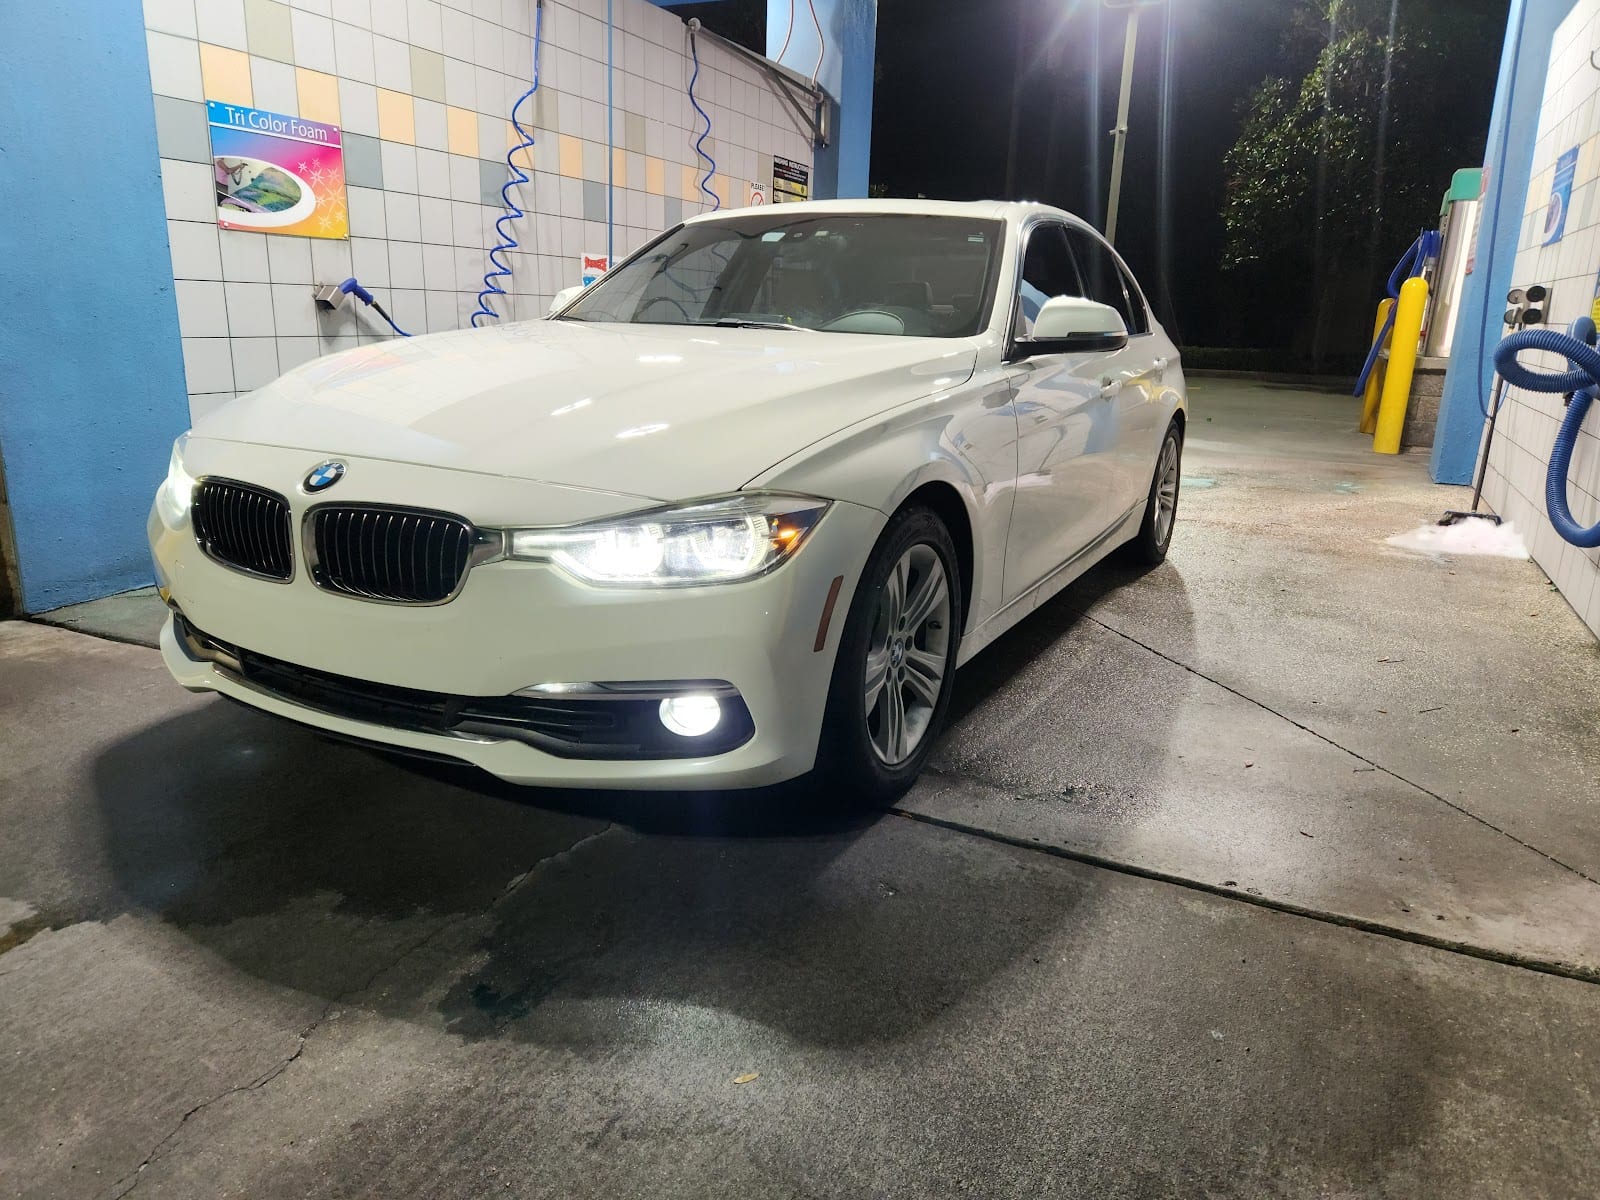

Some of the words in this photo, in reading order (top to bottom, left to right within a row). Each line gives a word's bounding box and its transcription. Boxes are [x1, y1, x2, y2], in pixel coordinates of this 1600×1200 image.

[225, 106, 245, 125] Tri
[248, 111, 288, 133] Color
[291, 119, 328, 141] Foam
